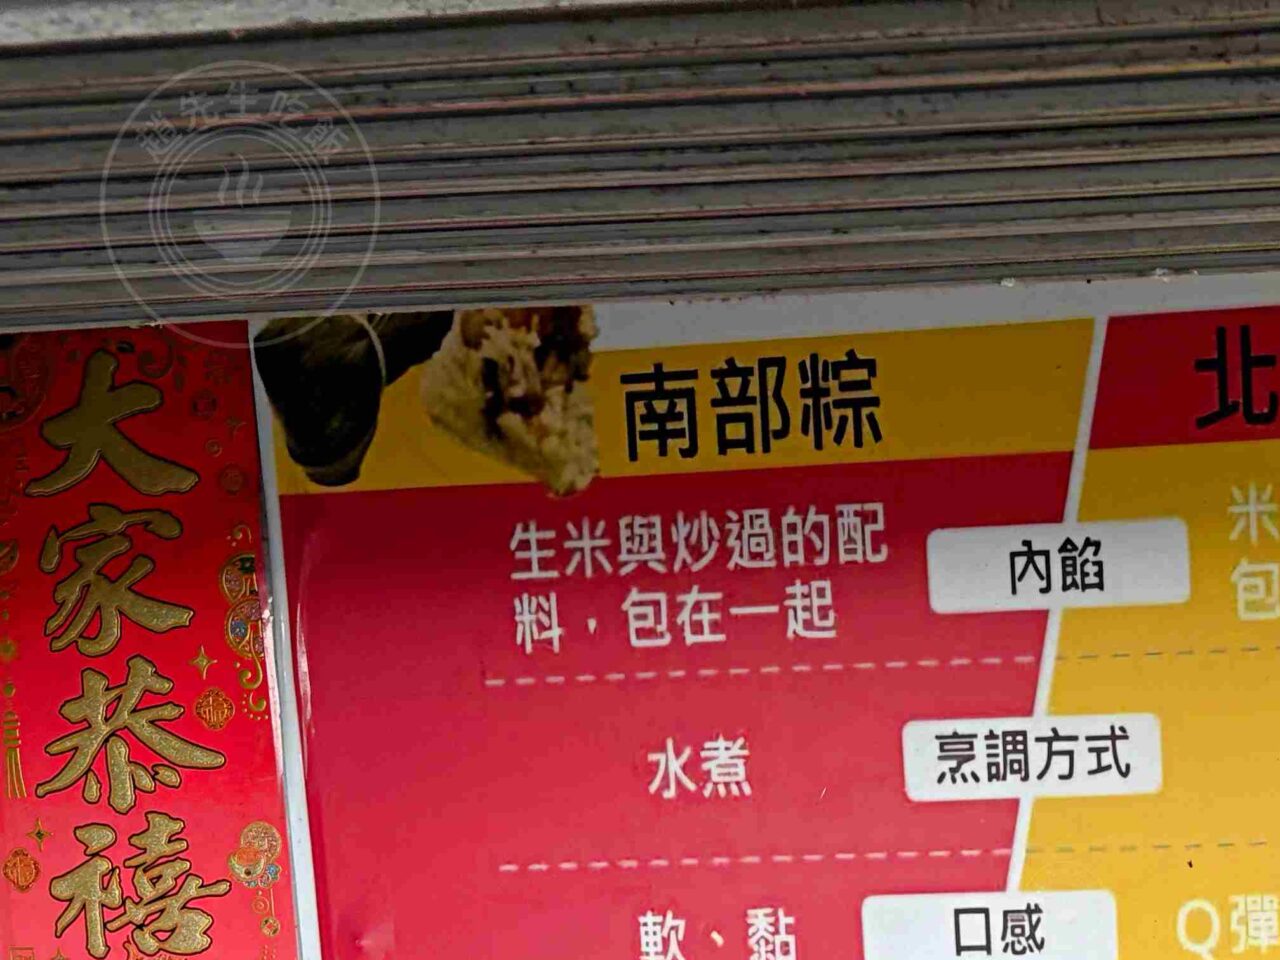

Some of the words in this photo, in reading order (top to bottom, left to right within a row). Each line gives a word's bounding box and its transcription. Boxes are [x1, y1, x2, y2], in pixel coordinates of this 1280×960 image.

[620, 350, 884, 462] 南部粽
[509, 503, 889, 581] 生米與炒過的配
[647, 733, 753, 800] 水煮
[934, 724, 1132, 785] 烹調方式
[953, 903, 1046, 957] 口感
